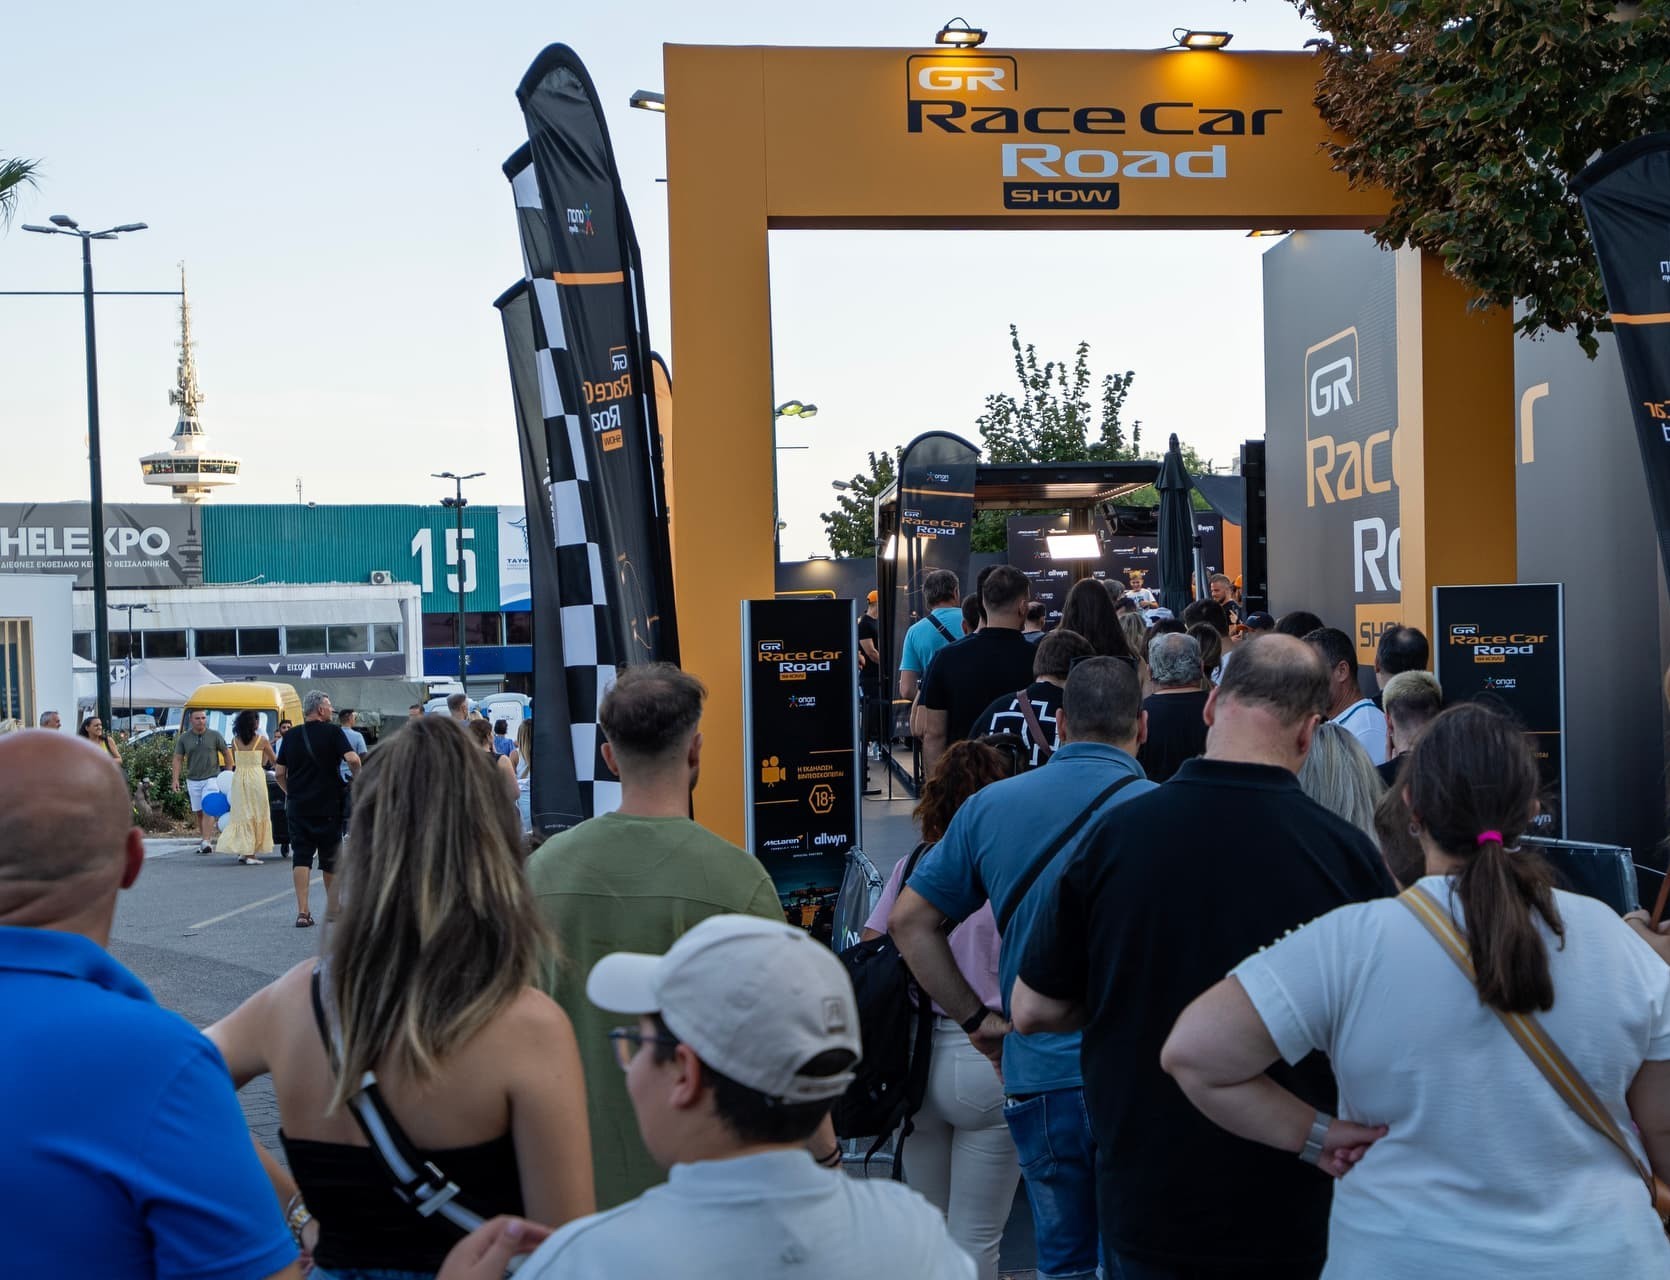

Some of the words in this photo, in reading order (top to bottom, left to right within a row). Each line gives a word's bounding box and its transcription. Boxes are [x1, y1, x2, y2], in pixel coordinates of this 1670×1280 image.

[918, 66, 1005, 91] GR
[907, 100, 1126, 134] Race
[1140, 102, 1283, 136] Car
[1002, 143, 1227, 178] Road
[1010, 189, 1112, 203] SHOW
[1310, 356, 1354, 416] GR
[917, 525, 956, 535] Road
[411, 528, 477, 593] 15
[1450, 635, 1507, 645] Race
[1510, 634, 1549, 644] Car
[759, 651, 808, 662] Race
[810, 650, 842, 660] Car
[1474, 645, 1533, 655] Road
[320, 662, 356, 671] ENTRANCE
[780, 661, 830, 672] Road
[815, 792, 836, 806] 18+
[814, 832, 847, 846] allwyn
